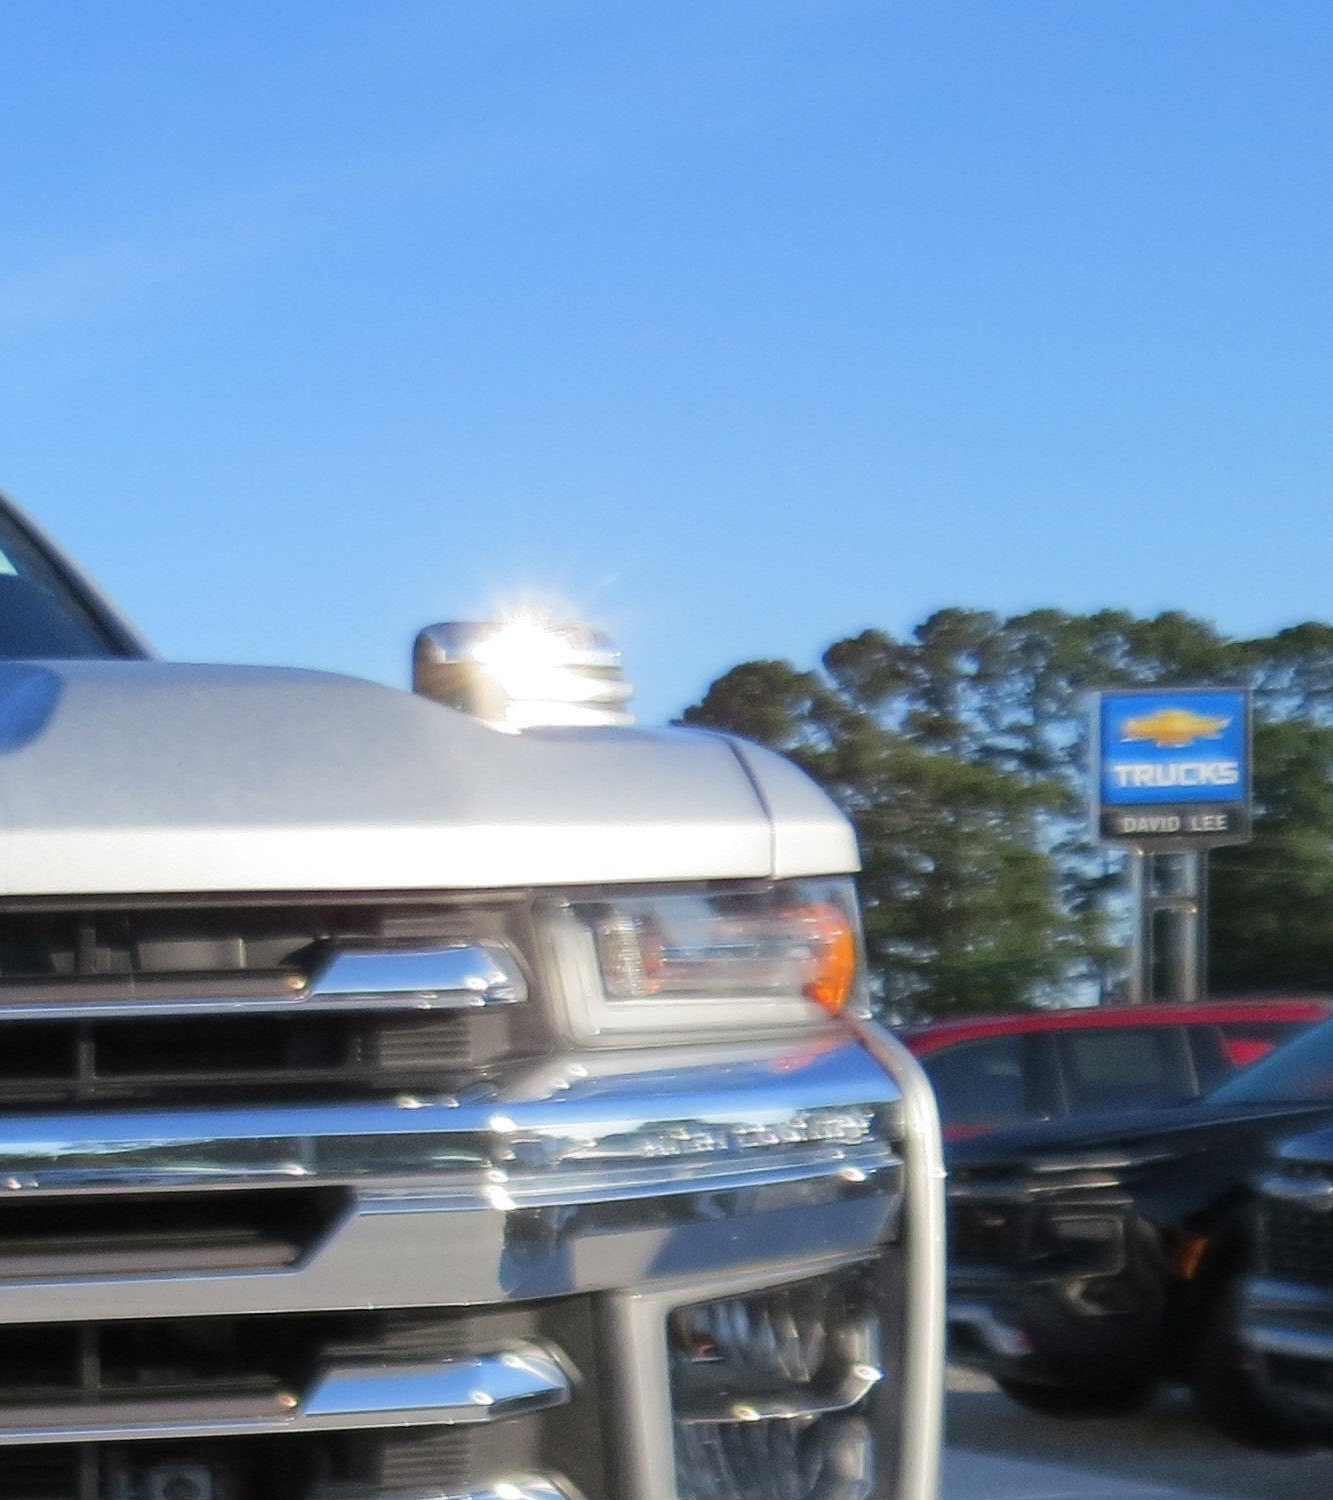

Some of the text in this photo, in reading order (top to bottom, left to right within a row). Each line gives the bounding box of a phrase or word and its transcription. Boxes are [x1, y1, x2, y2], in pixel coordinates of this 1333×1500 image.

[1113, 761, 1240, 787] TRUCKS
[1123, 815, 1228, 832] DAVID LEE
